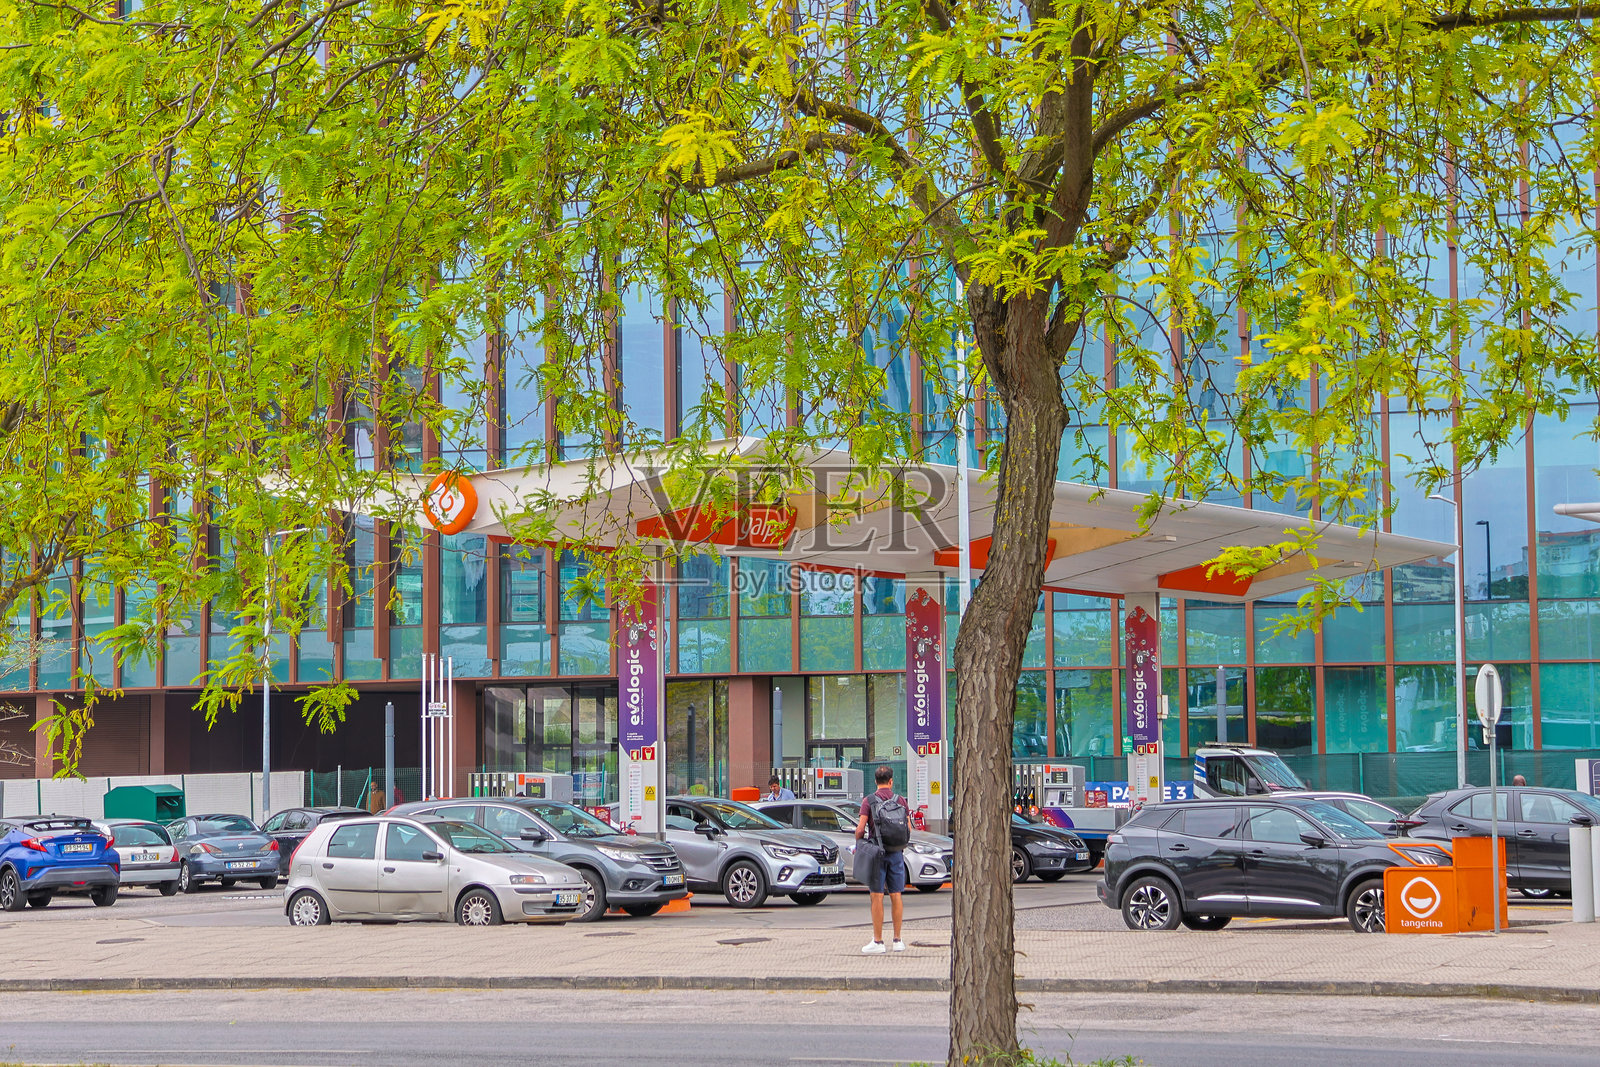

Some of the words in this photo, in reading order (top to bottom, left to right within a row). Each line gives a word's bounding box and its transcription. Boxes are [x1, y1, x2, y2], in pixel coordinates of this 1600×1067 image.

[627, 649, 644, 725] evologic
[914, 660, 930, 726] evologic
[1133, 670, 1147, 728] evologic
[1176, 786, 1187, 800] 3
[1400, 919, 1443, 929] tangerina
